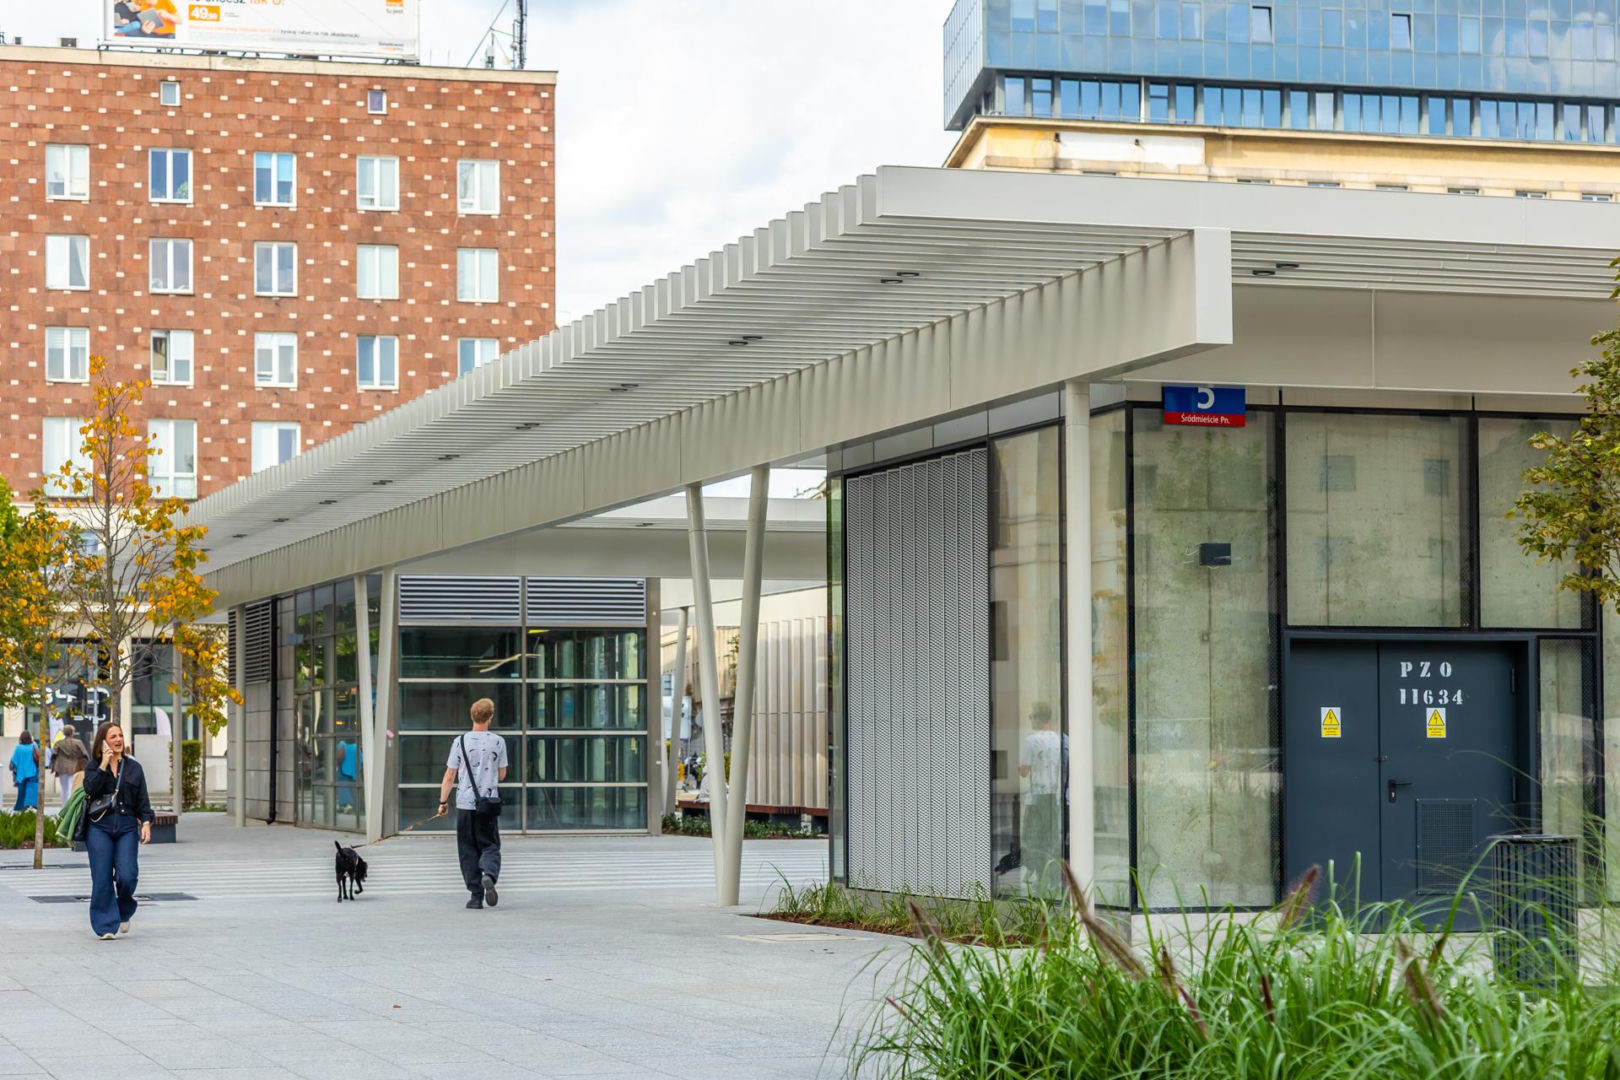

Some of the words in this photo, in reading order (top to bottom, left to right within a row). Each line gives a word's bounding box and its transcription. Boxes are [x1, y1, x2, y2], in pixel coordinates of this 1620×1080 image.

[1181, 412, 1219, 424] Śródmieście
[1220, 415, 1231, 425] Pn.
[1399, 688, 1464, 705] 11634
